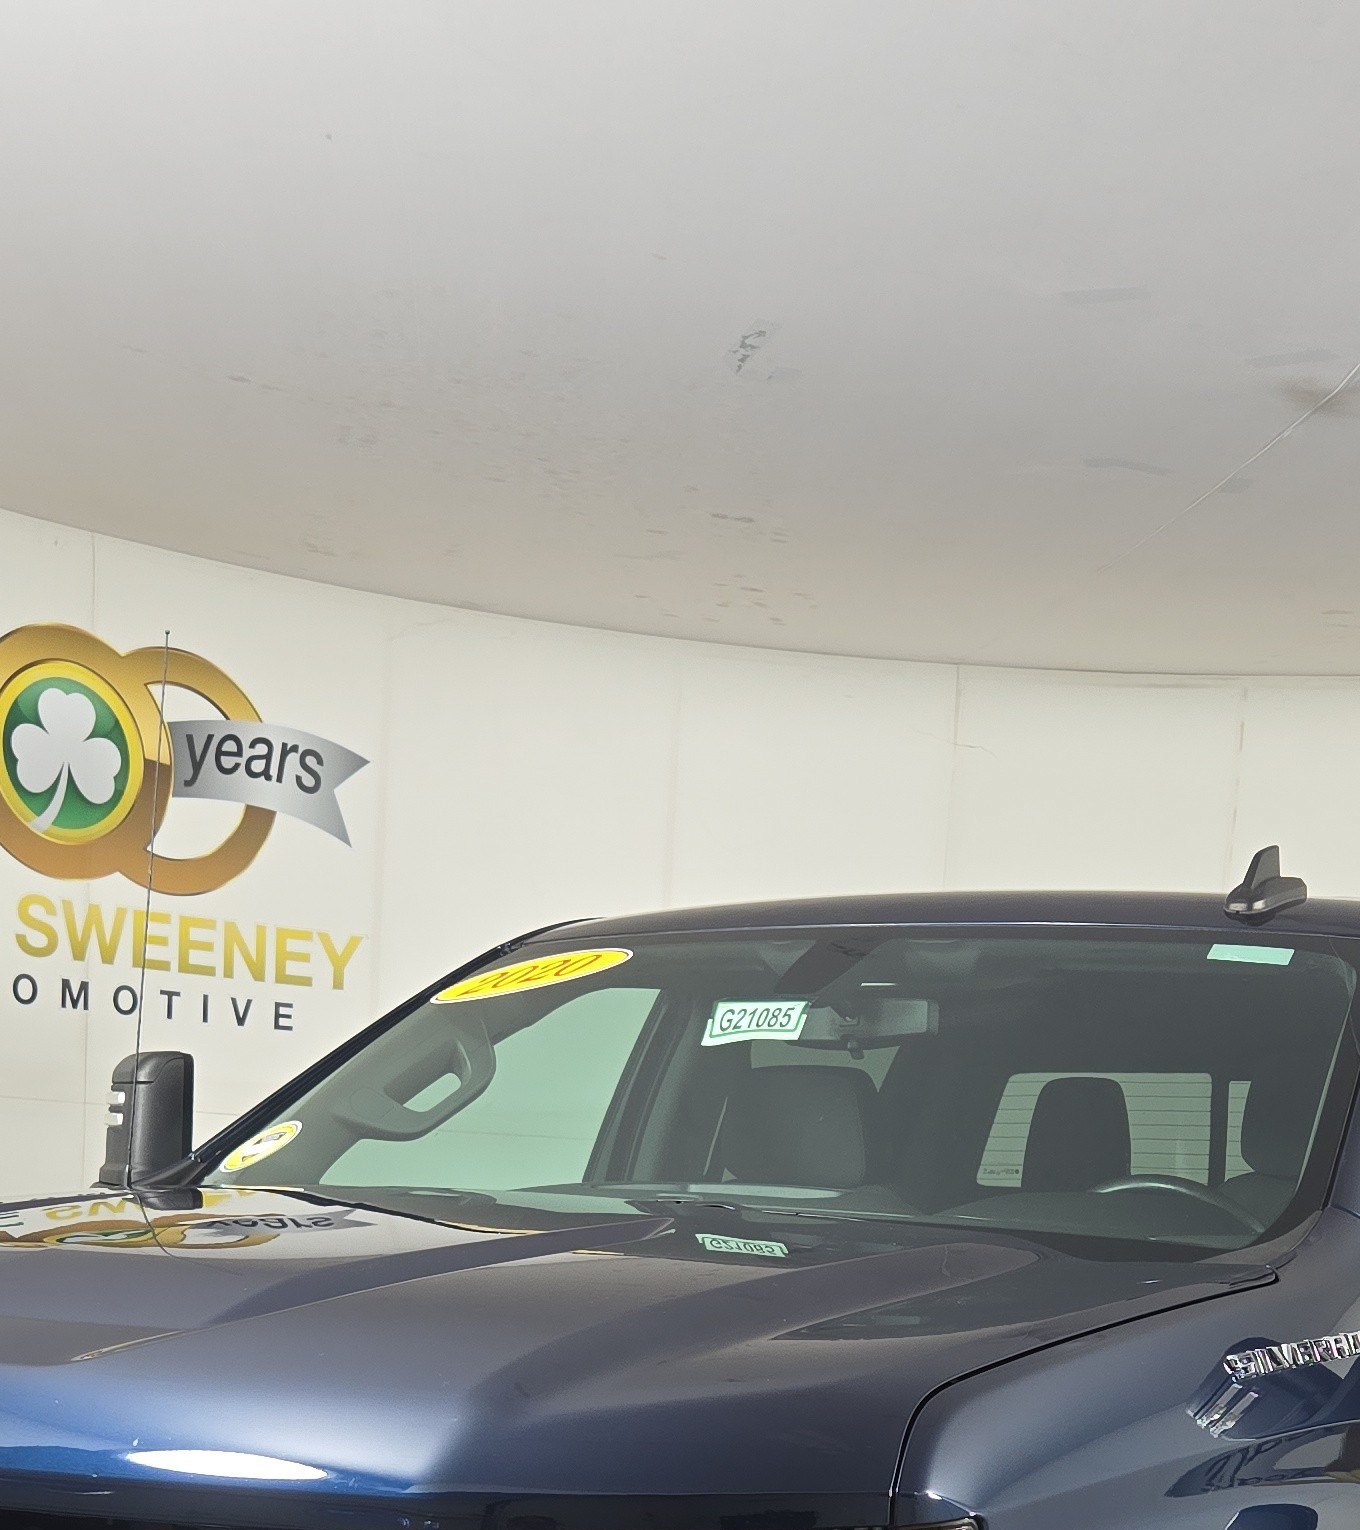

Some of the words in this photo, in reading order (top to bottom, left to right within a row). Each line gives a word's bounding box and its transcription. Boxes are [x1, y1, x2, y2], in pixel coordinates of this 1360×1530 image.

[182, 729, 325, 795] years
[15, 893, 363, 991] SWEENEY
[456, 954, 603, 997] 2020
[719, 1007, 796, 1032] G21085
